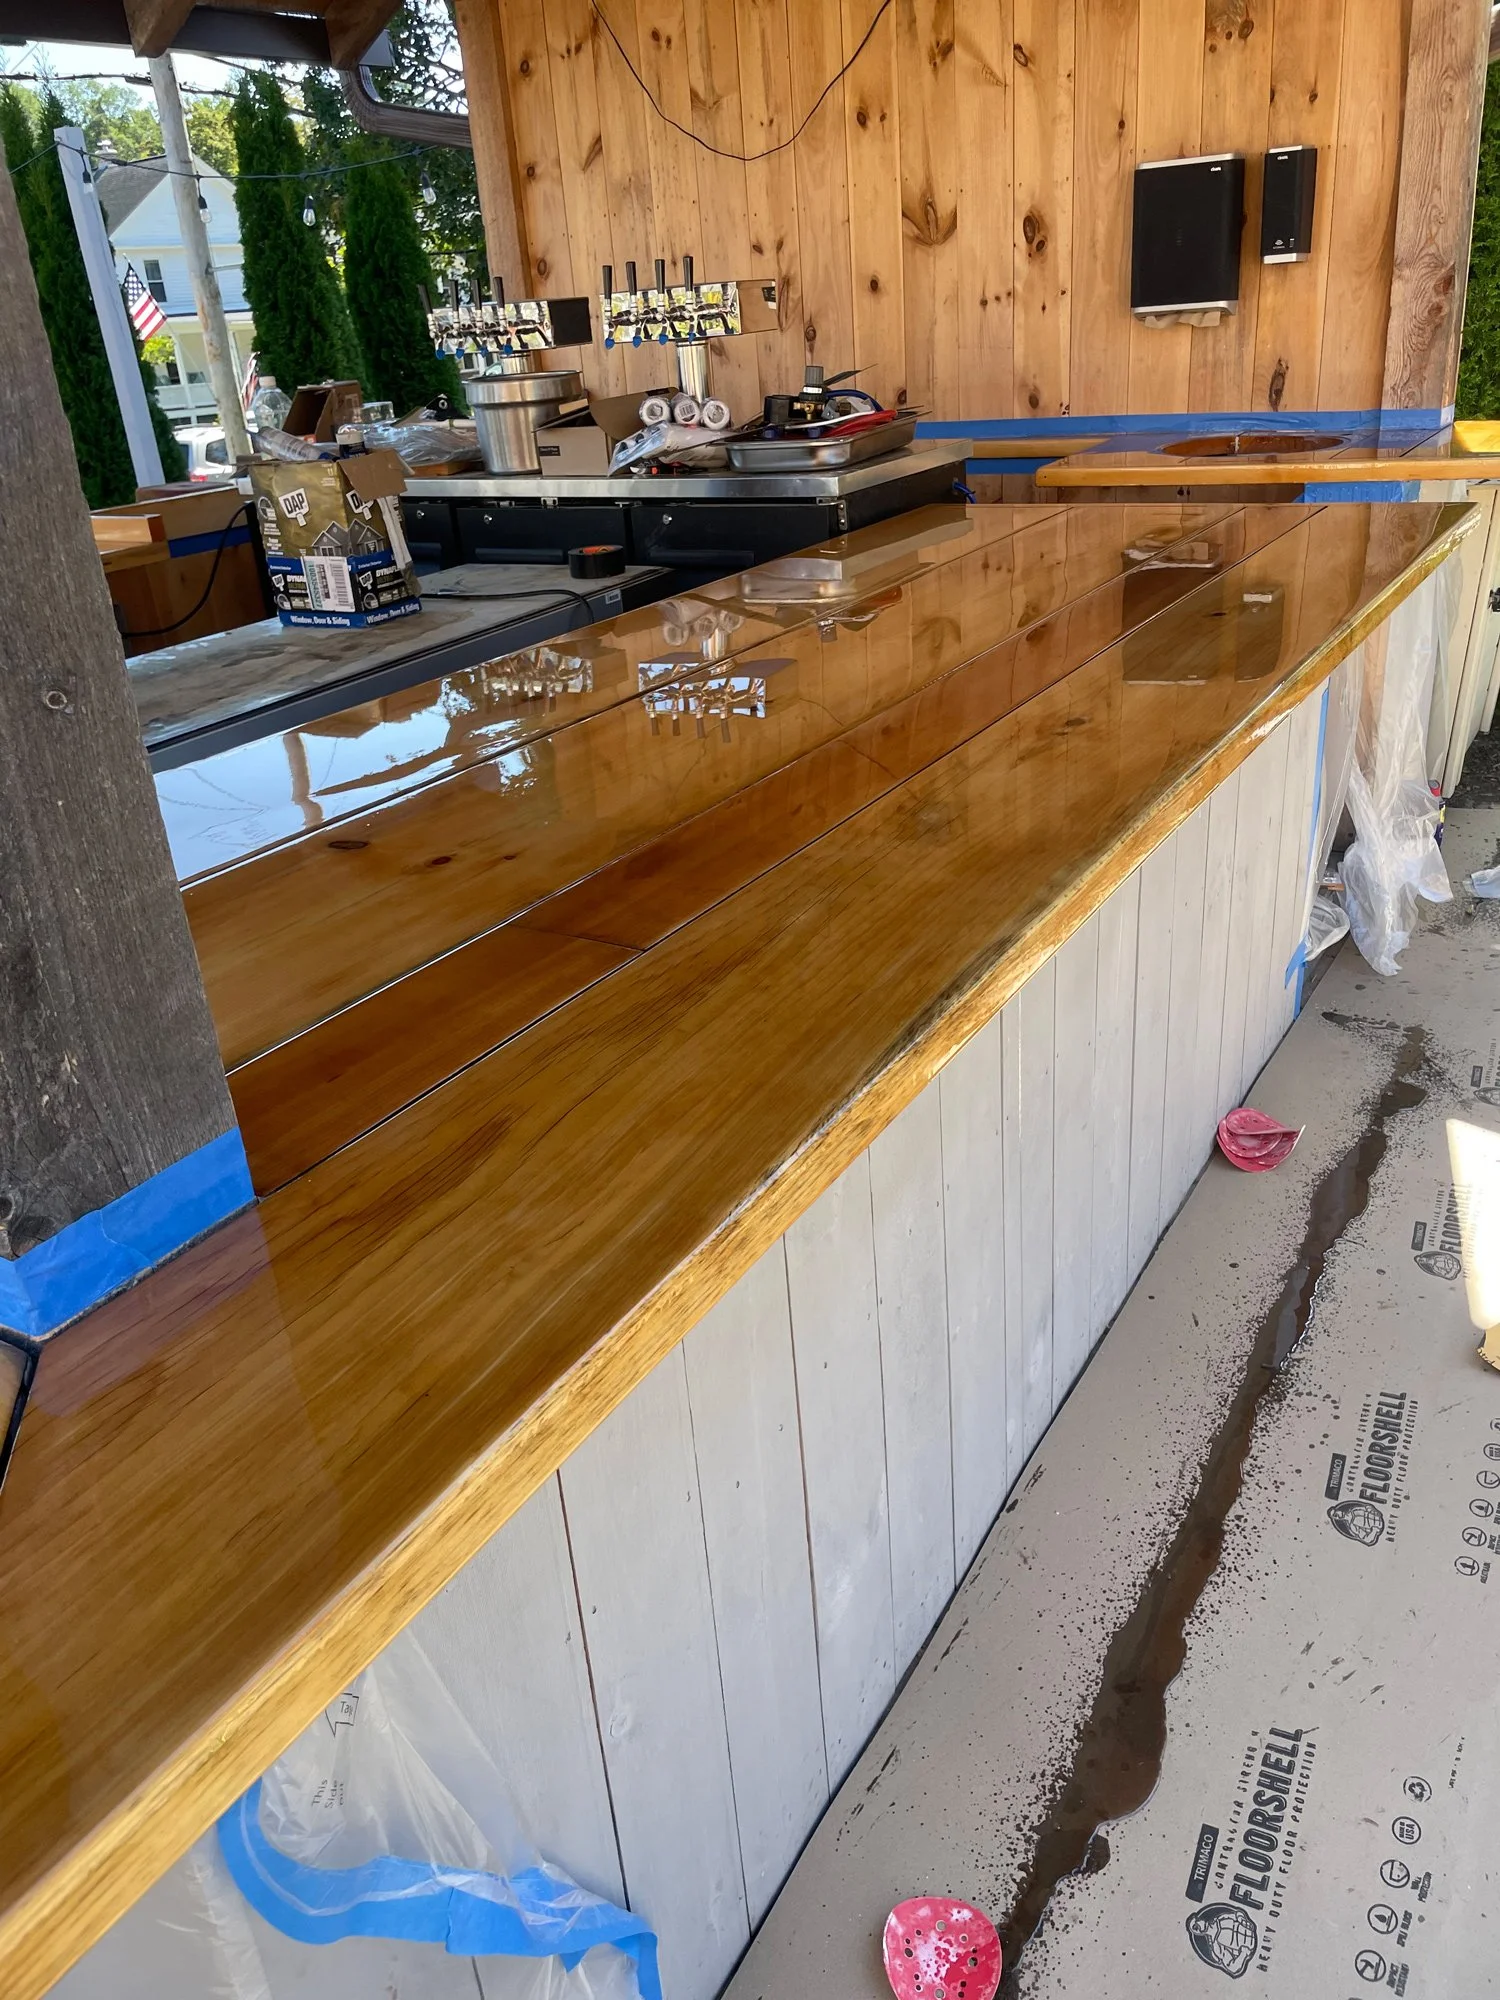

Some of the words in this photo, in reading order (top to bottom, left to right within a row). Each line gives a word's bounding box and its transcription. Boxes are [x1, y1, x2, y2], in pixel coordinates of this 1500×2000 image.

[283, 492, 305, 514] DAP
[1359, 1391, 1407, 1505] FLOORSHELL
[1330, 1458, 1343, 1488] TRIMACO
[1396, 1453, 1409, 1483] FLOOR
[311, 1779, 328, 1807] This
[1229, 1727, 1304, 1911] FLOORSHELL
[1404, 1822, 1417, 1840] USA
[1194, 1833, 1214, 1882] TRIMACO
[1255, 1925, 1277, 1972] HEAVY
[1268, 1880, 1288, 1918] DUTY
[1278, 1830, 1299, 1875] FLOOR
[1291, 1741, 1317, 1823] PROTECTION
